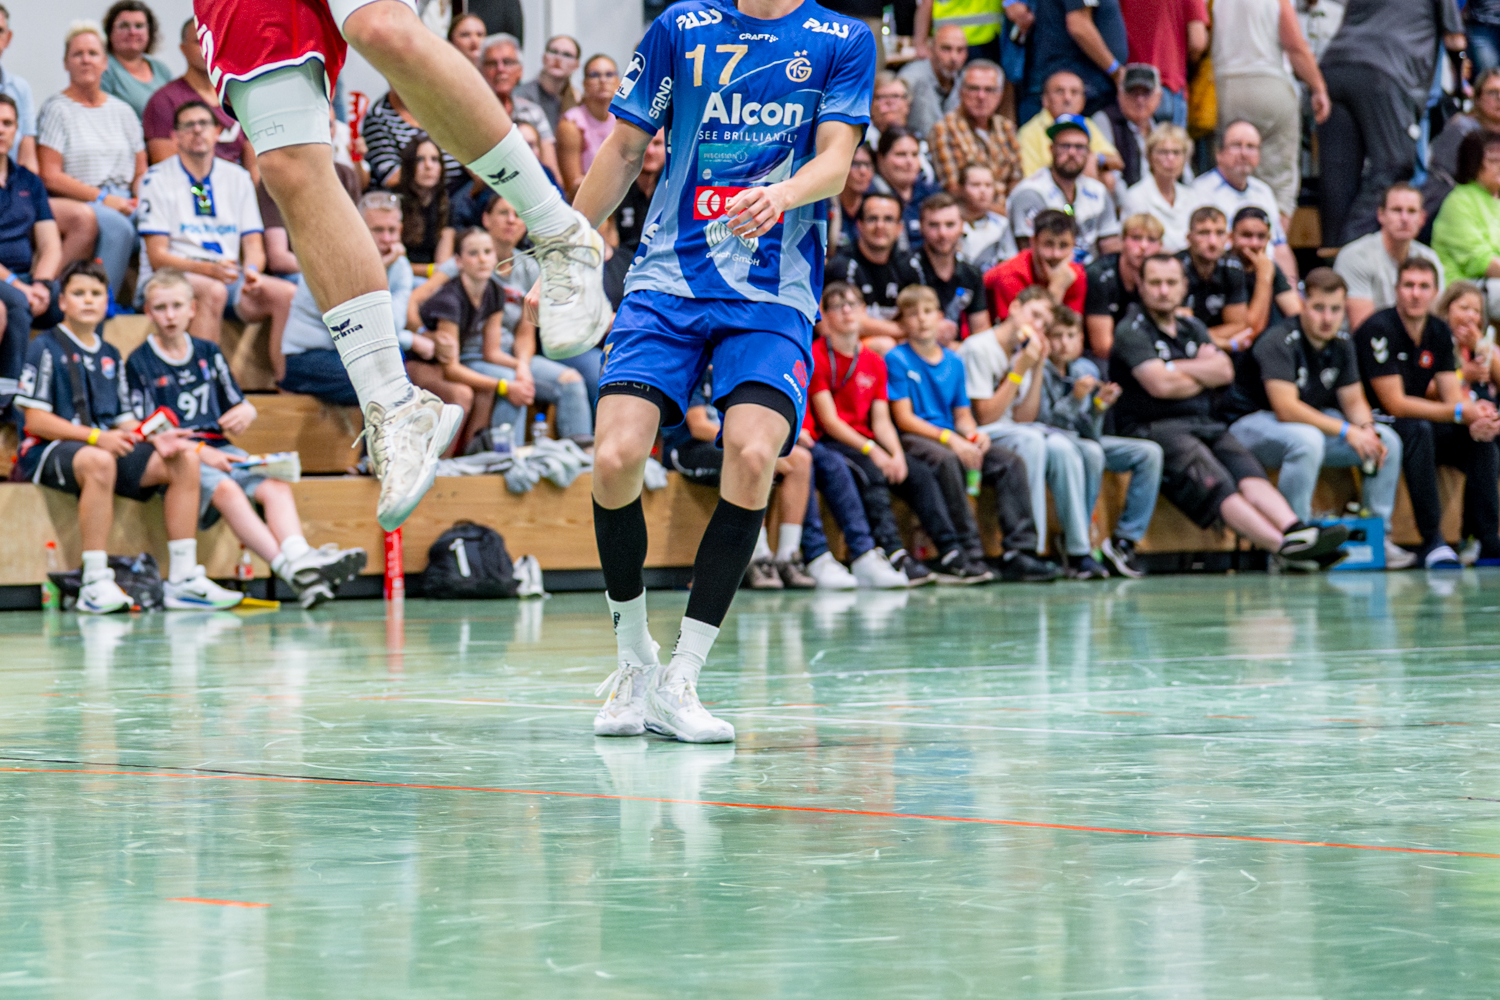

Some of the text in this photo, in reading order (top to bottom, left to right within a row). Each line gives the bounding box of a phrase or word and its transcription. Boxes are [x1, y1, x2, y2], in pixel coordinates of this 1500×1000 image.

[676, 8, 723, 31] PASS
[802, 17, 849, 38] PASS
[739, 33, 771, 41] CRAFT
[685, 44, 748, 87] 17
[702, 92, 804, 127] Alcon
[698, 130, 719, 140] SEE
[731, 253, 760, 267] GmbH
[177, 382, 211, 421] 97
